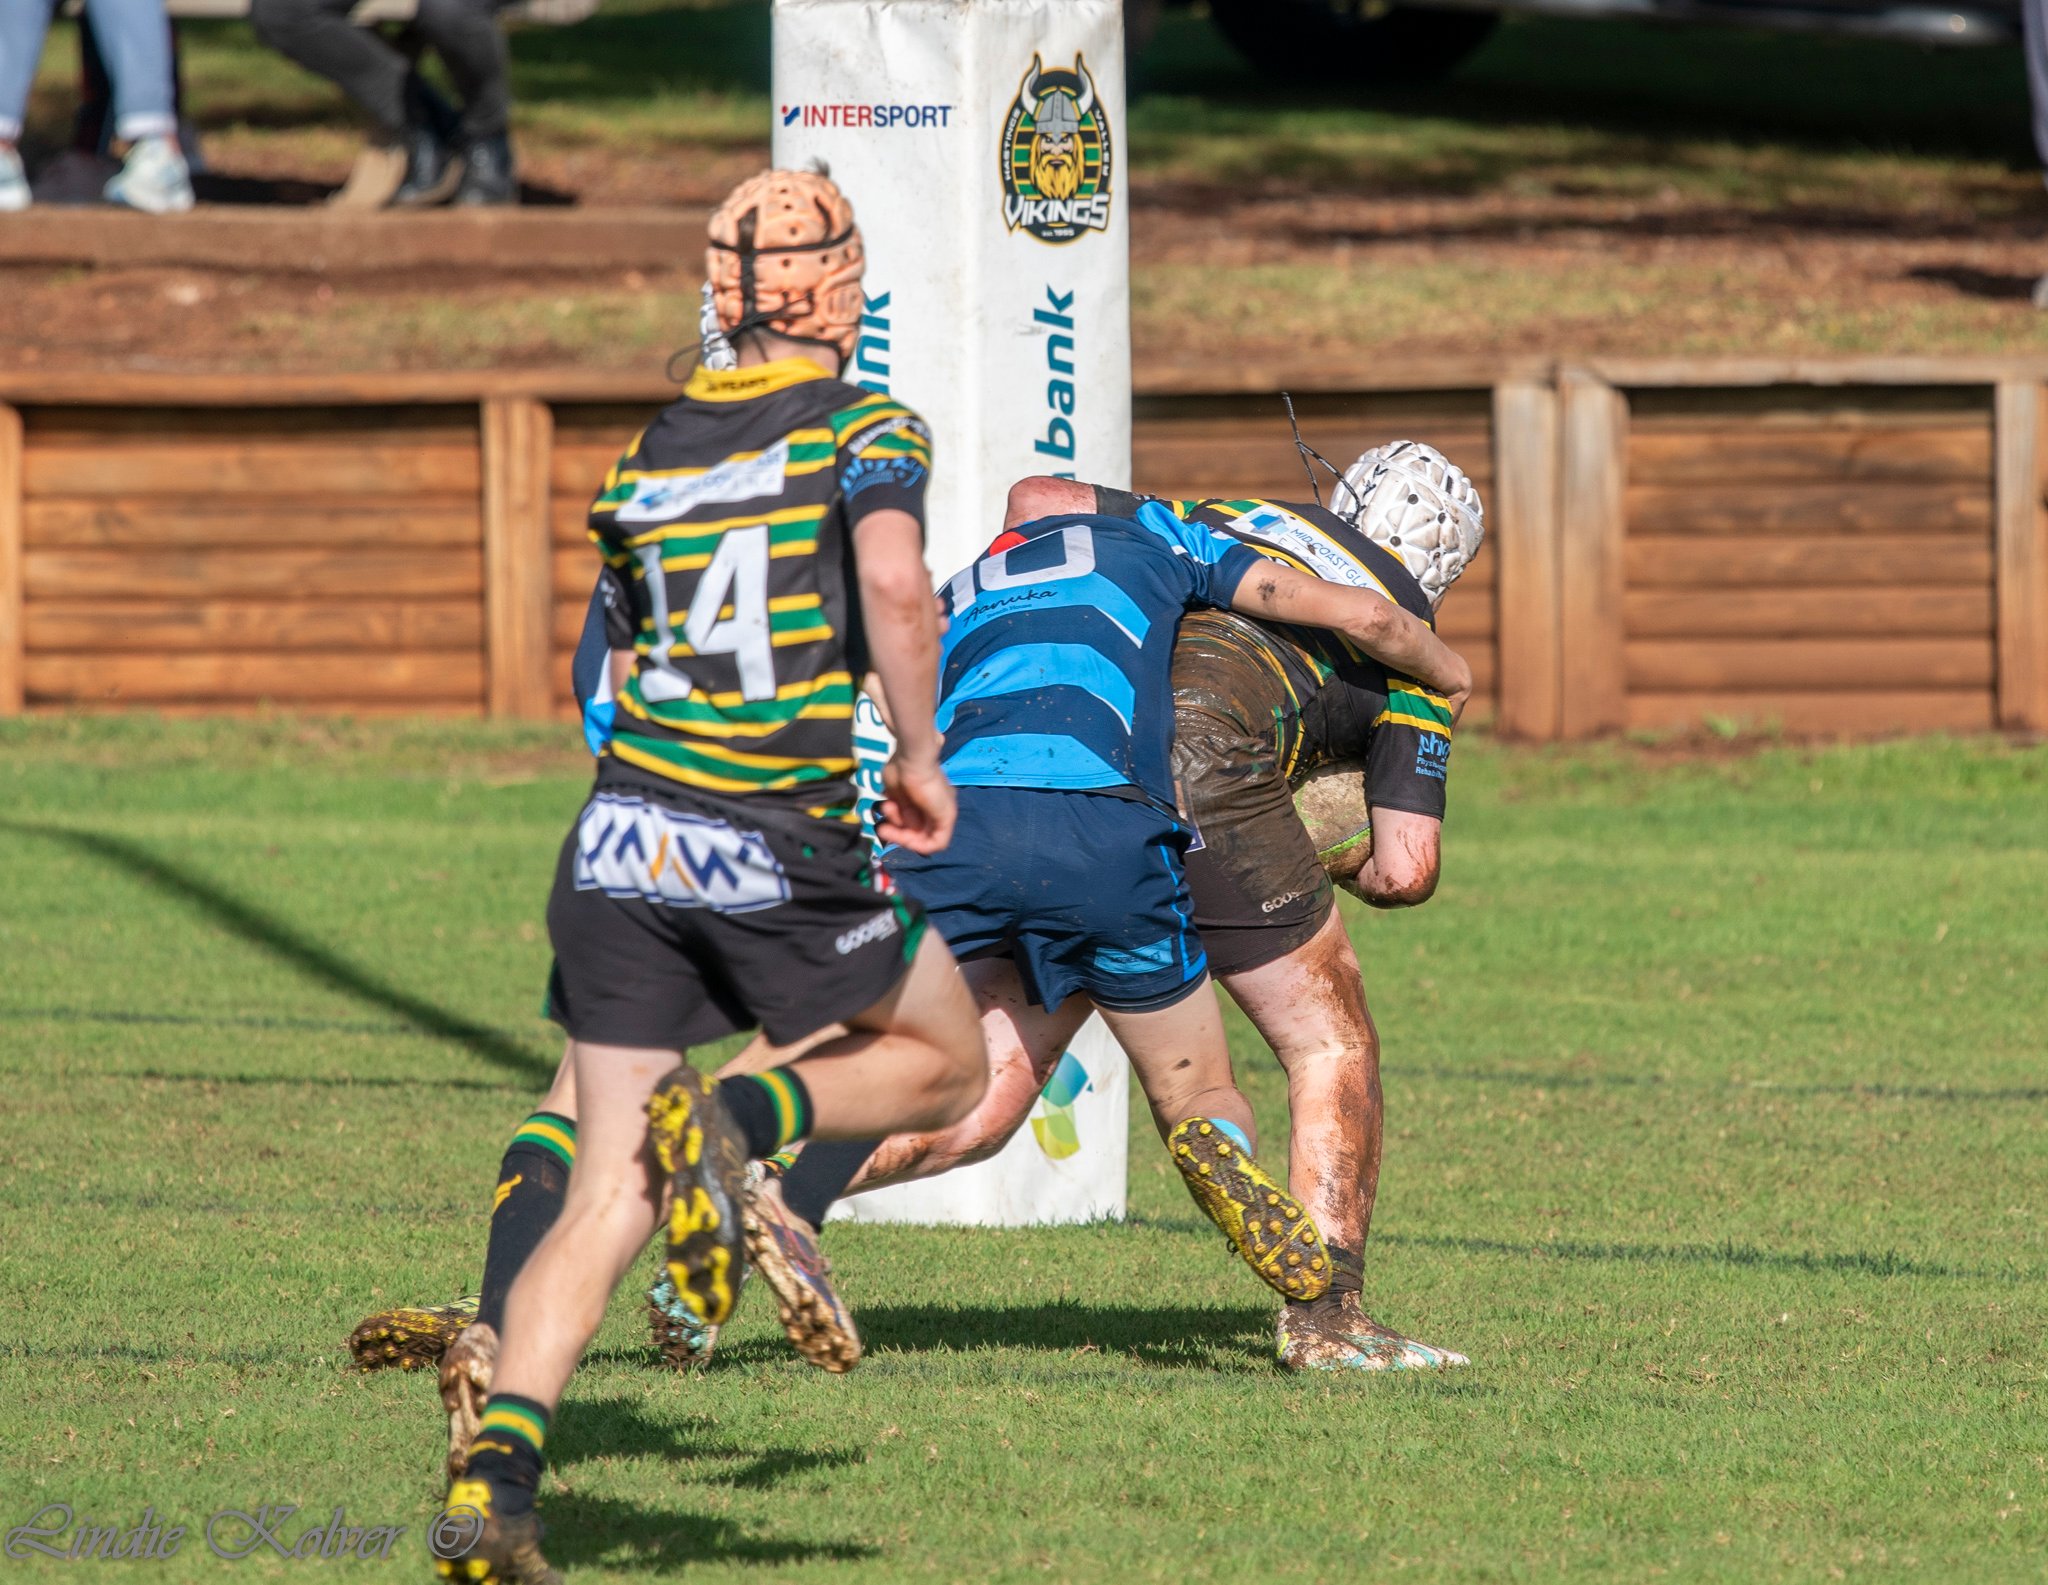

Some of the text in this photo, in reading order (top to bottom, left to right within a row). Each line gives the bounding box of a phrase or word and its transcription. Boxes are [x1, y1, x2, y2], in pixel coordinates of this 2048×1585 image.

[803, 106, 951, 128] INTERSPORT
[1003, 193, 1110, 230] VIKINGS
[856, 290, 891, 396] nk
[1033, 283, 1075, 461] bank
[950, 525, 1096, 618] 10
[1345, 570, 1370, 589] GLA
[634, 524, 777, 703] 14
[1261, 889, 1303, 913] GOOS
